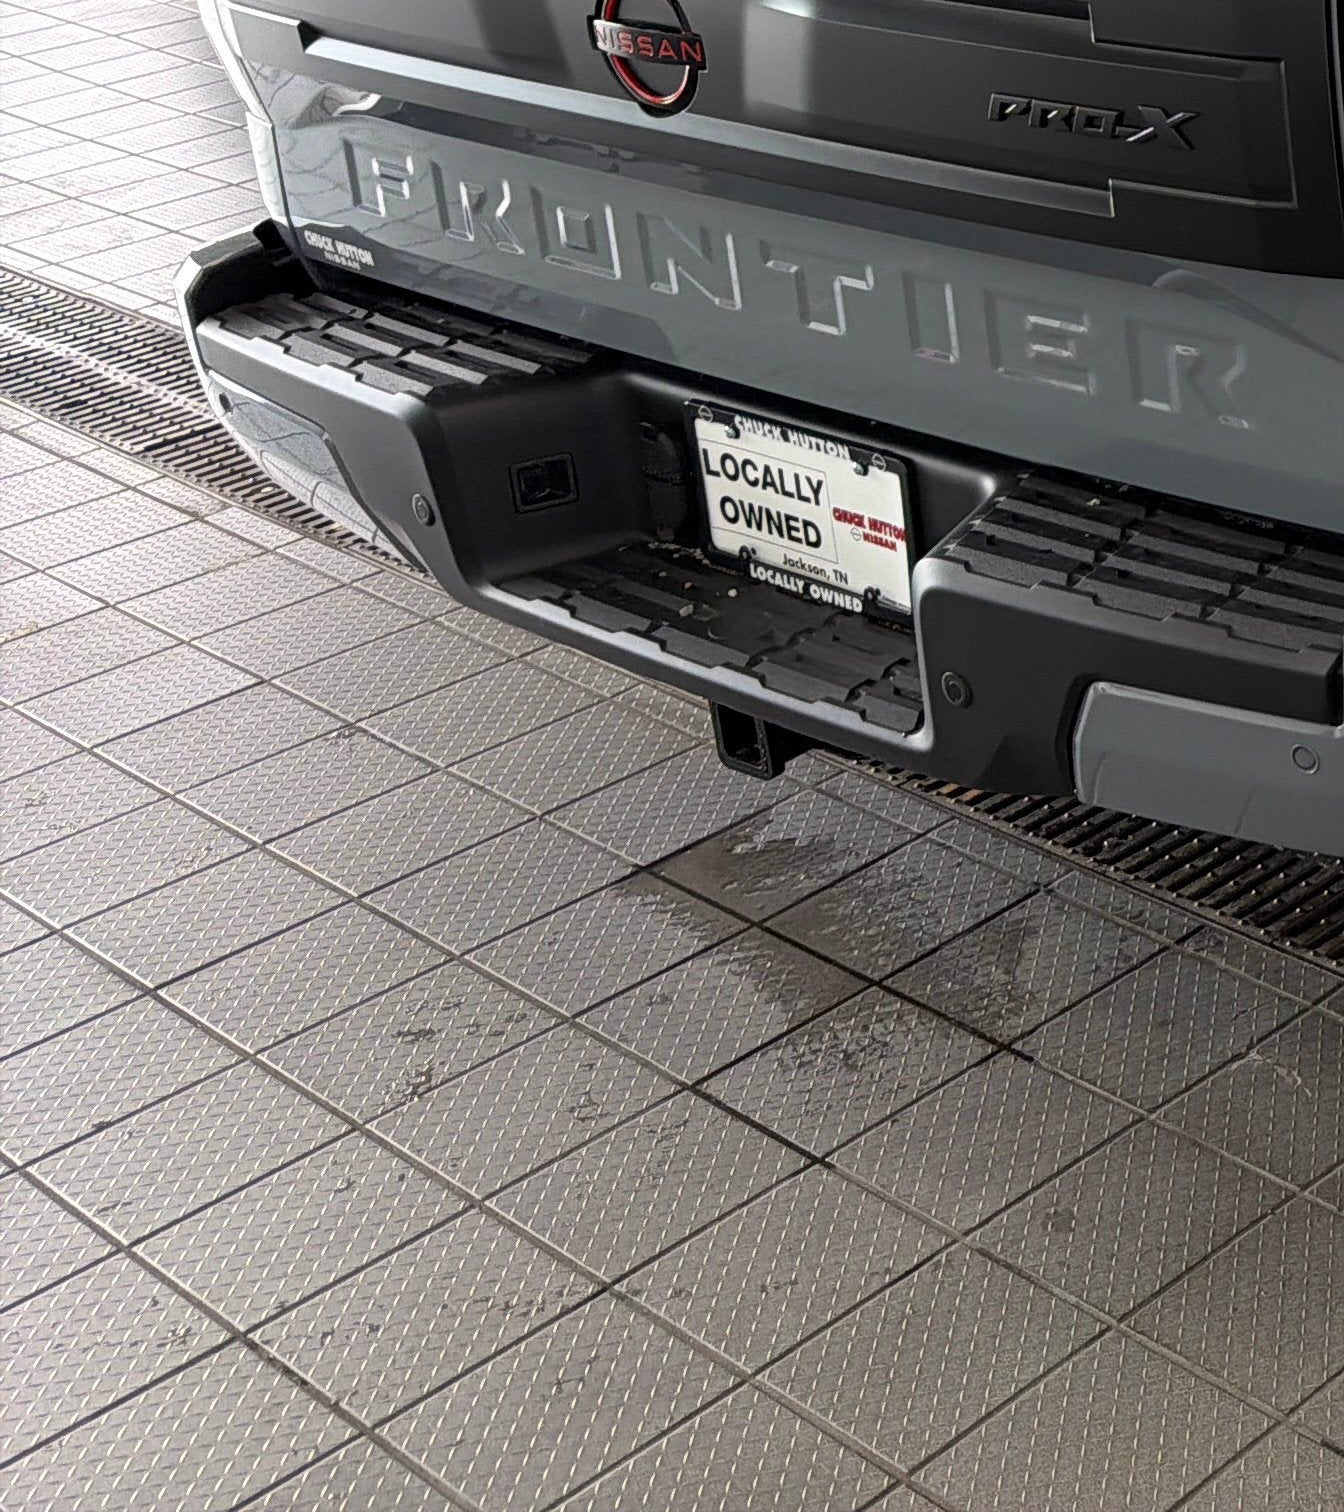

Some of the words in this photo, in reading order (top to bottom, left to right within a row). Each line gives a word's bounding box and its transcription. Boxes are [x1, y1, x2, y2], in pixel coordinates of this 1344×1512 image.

[594, 24, 703, 62] NISSAN
[304, 229, 336, 253] CHUCK
[334, 239, 375, 267] HUTTON
[345, 140, 1252, 429] FRONTIER
[734, 415, 781, 440] CHUCK
[788, 428, 851, 460] HUTTON
[702, 448, 823, 506] LOCALLY
[719, 496, 822, 549] OWNED
[832, 507, 866, 530] CHUCK
[867, 517, 907, 542] HUTTON
[862, 532, 898, 552] NISSAN
[750, 563, 805, 594] LOCALLY
[809, 584, 863, 613] OWNED
[782, 553, 831, 581] Jackson,
[832, 569, 849, 585] TN
